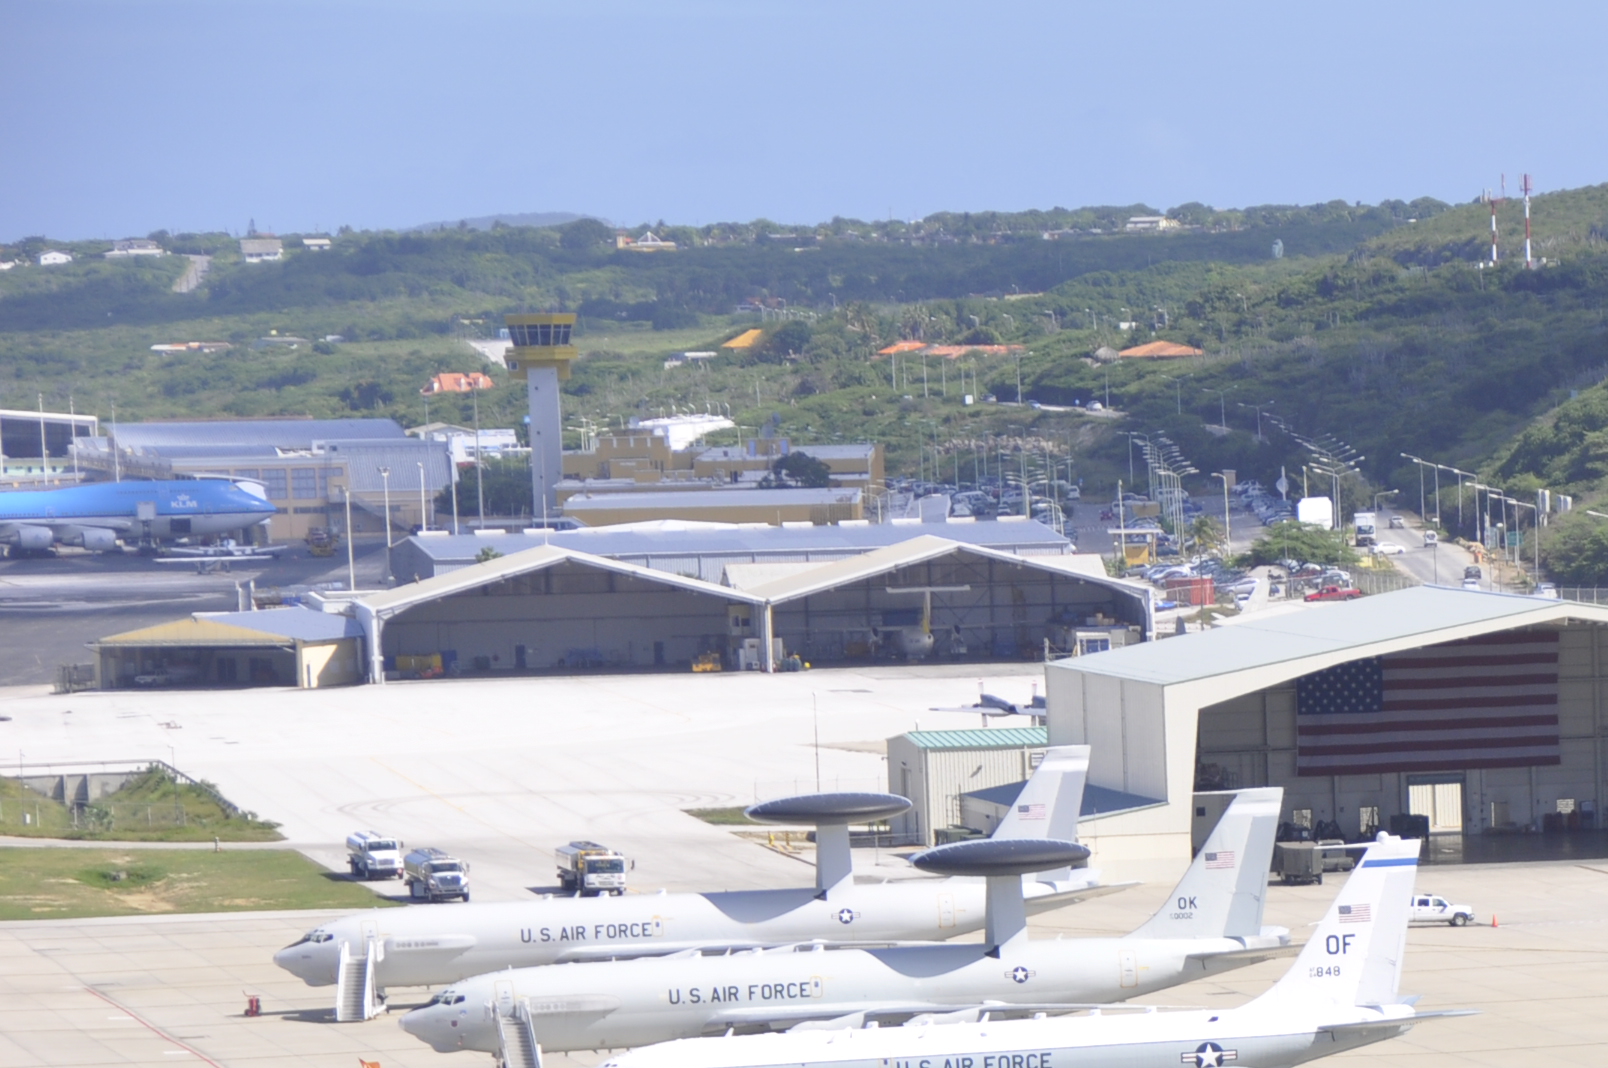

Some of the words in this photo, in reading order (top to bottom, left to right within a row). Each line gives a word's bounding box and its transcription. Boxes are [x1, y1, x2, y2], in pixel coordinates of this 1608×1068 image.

[171, 500, 198, 508] KLM
[1178, 896, 1198, 910] OK
[559, 926, 586, 942] AIR
[594, 922, 653, 940] FORCE
[1326, 934, 1356, 955] OF
[710, 985, 740, 1003] AIR
[748, 982, 811, 1000] FORCE
